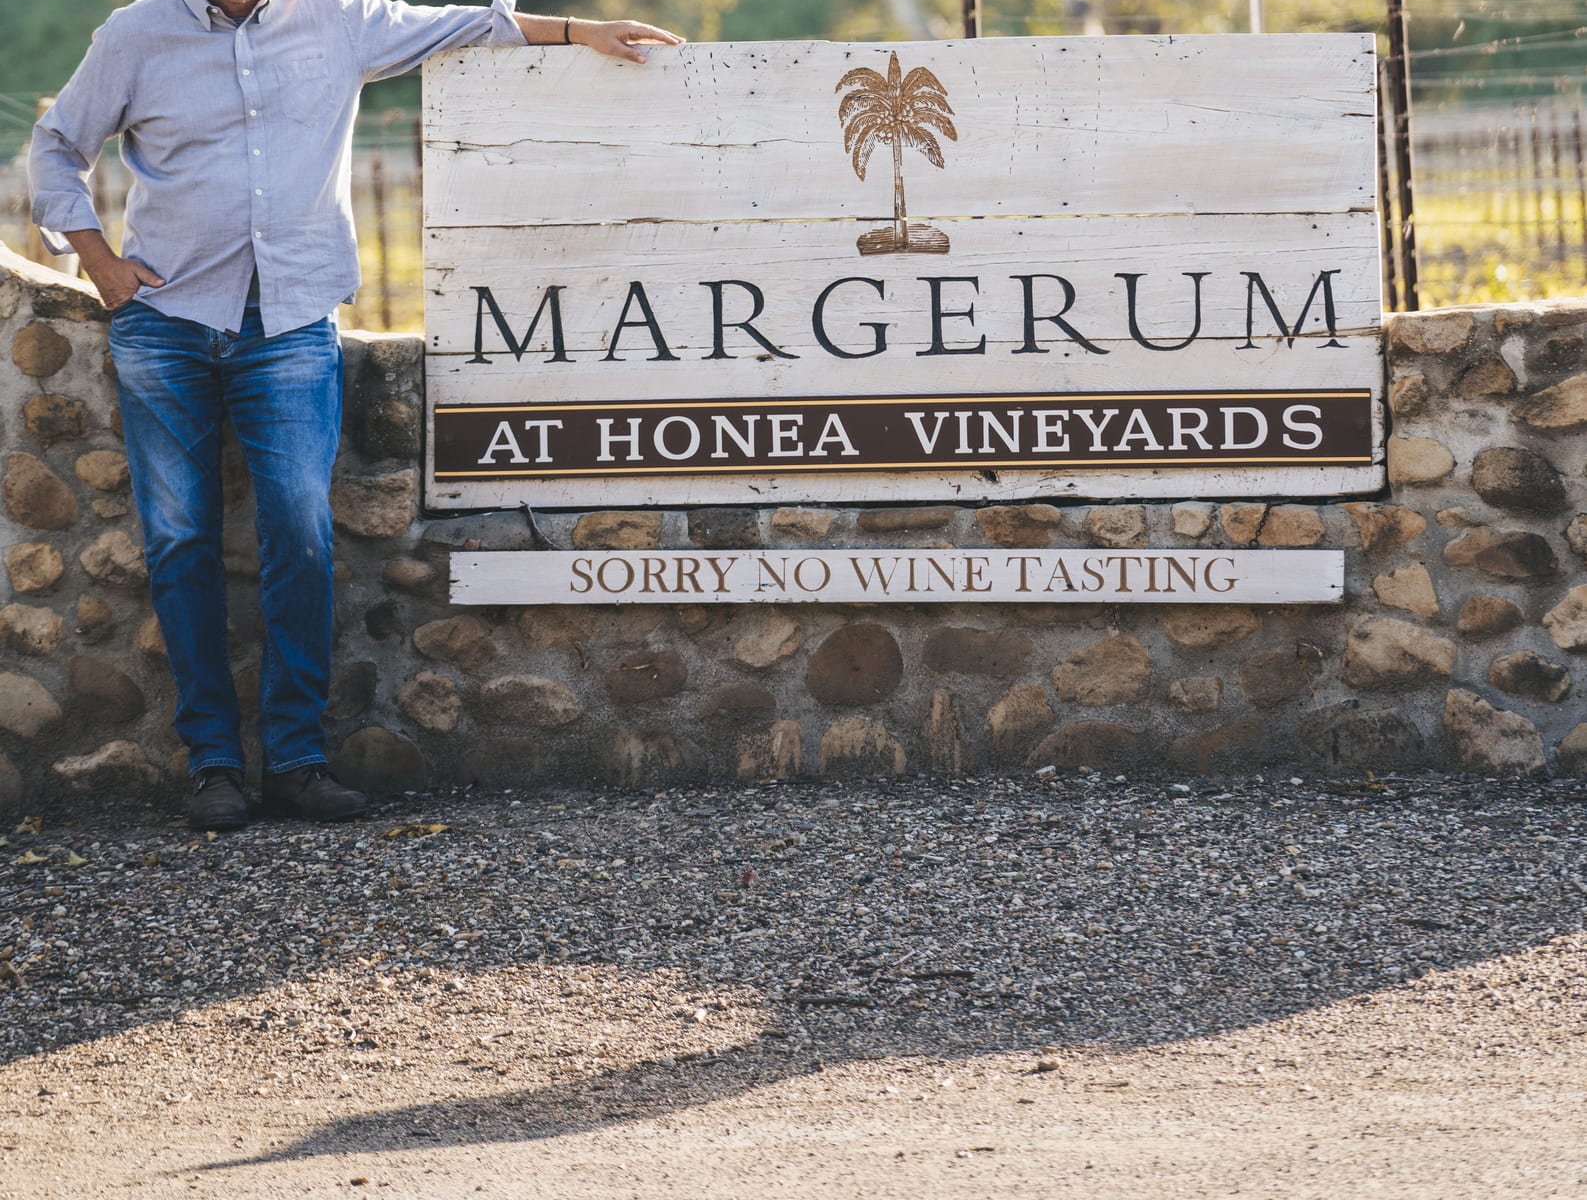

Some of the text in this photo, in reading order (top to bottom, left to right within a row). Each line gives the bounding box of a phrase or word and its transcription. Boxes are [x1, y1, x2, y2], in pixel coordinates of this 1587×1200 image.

[466, 269, 1348, 365] MARGERUM
[477, 404, 1324, 465] AT HONEA VINEYARDS
[569, 555, 1240, 594] SORRY NO WINE TASTING
